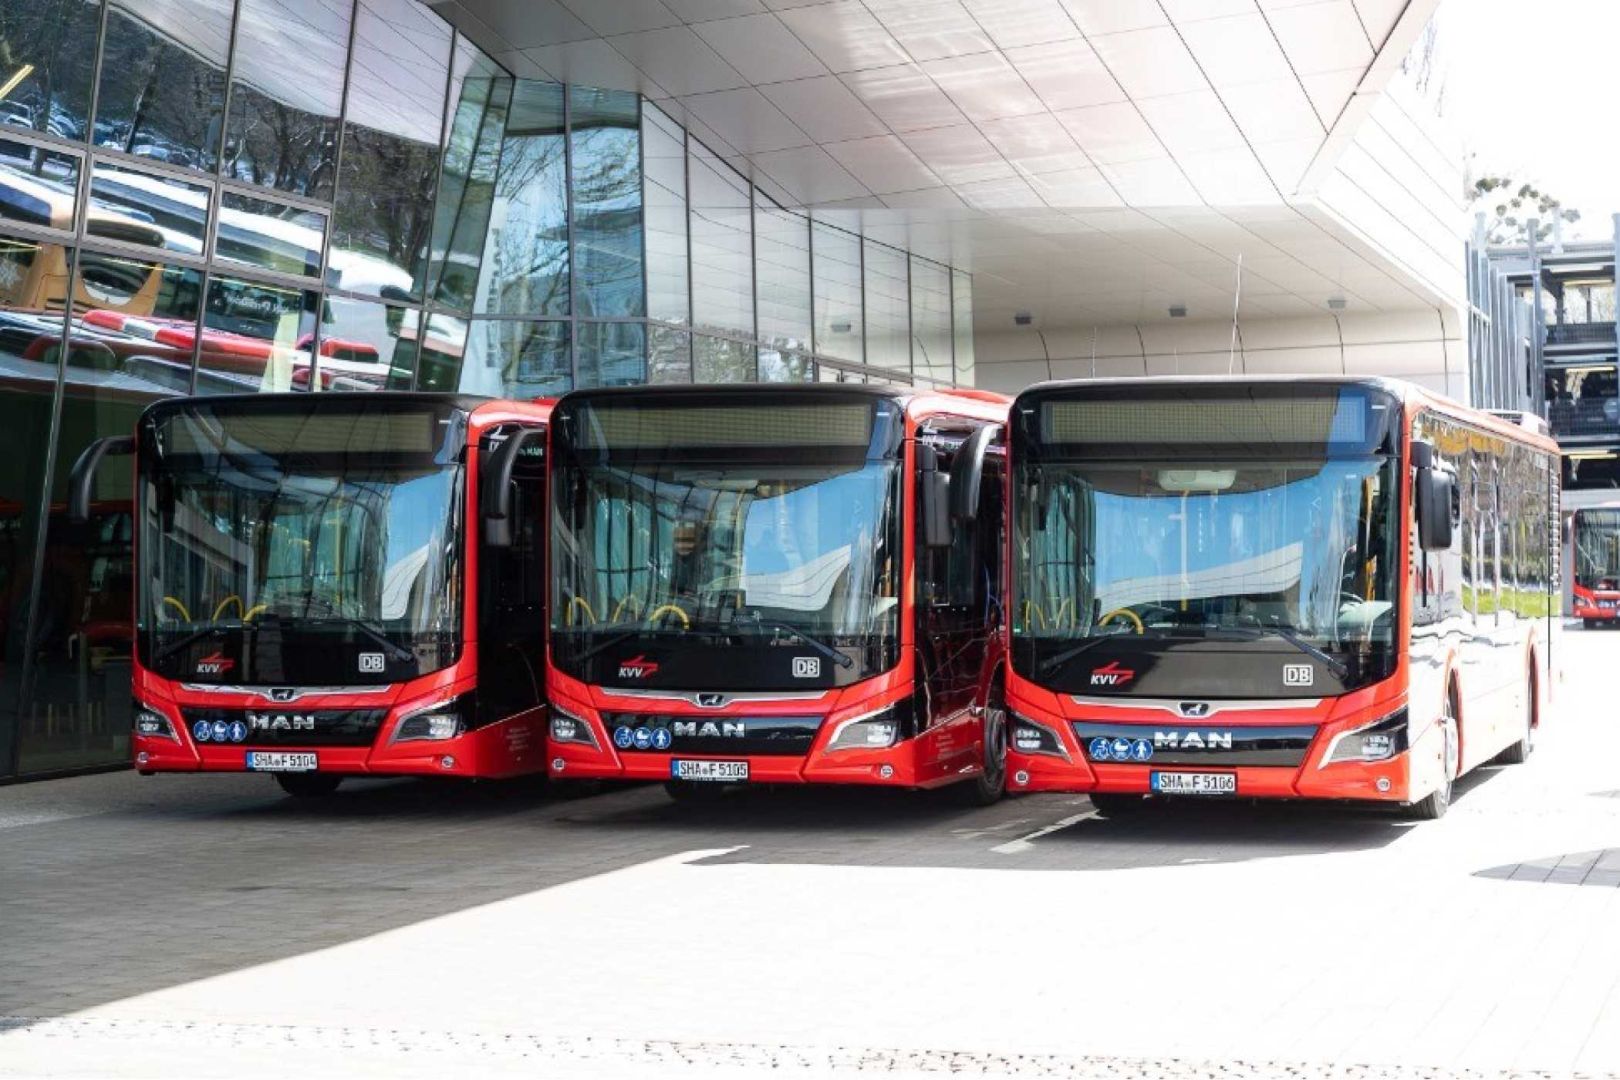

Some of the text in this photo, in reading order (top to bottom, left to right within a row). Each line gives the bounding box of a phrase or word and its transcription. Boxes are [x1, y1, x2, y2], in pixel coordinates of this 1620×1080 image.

[196, 663, 220, 673] KVV
[361, 655, 383, 670] DB
[795, 659, 818, 675] DB
[618, 666, 643, 678] KVV
[1090, 674, 1118, 685] KVV
[1286, 667, 1311, 683] DB
[250, 714, 315, 730] MAN
[673, 721, 745, 738] MAN
[1153, 731, 1232, 748] MAN
[254, 753, 316, 767] SHA F 5104
[680, 762, 747, 777] SHA F 5105
[1160, 775, 1234, 790] SHA F 5106
